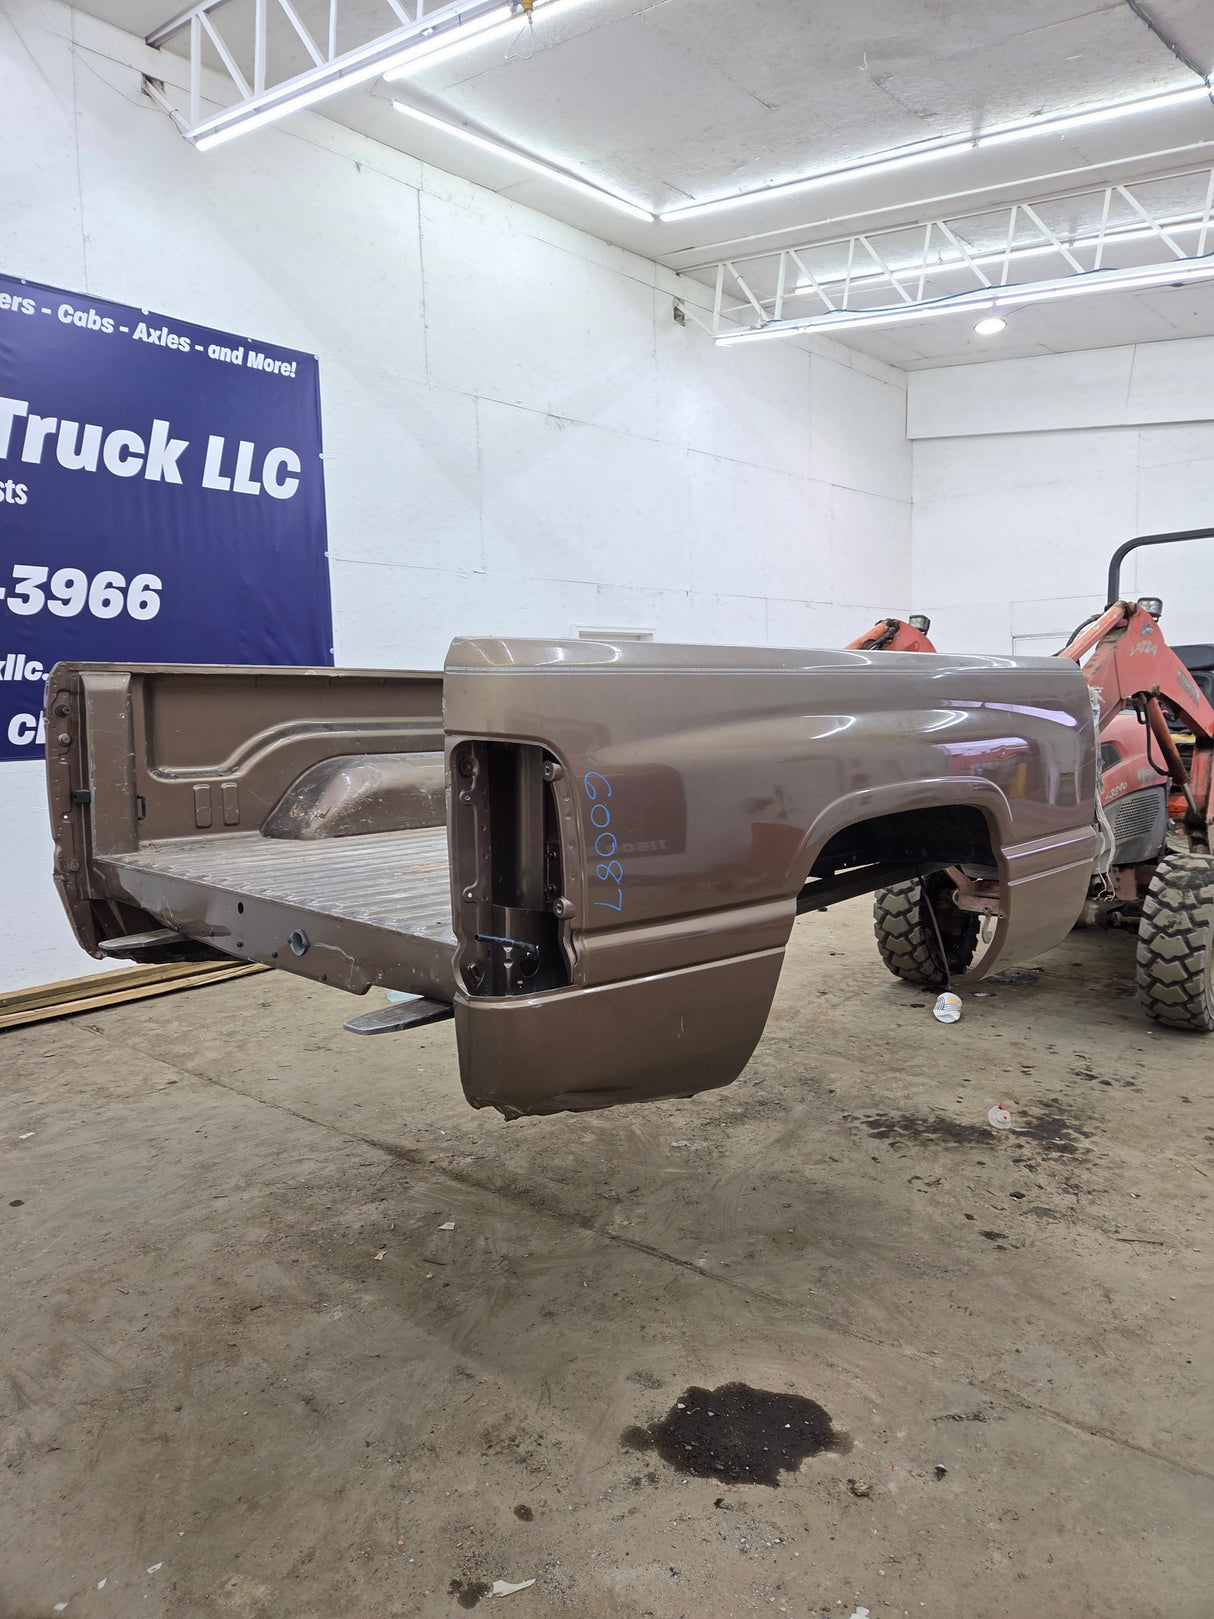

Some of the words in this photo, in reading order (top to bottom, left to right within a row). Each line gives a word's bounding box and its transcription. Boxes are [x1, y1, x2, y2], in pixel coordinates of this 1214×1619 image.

[0, 292, 36, 315] ers
[57, 303, 115, 334] Cabs
[132, 321, 191, 352] Axles
[207, 344, 244, 366] and
[246, 351, 297, 378] More!
[0, 396, 190, 485] Truck
[201, 434, 302, 500] LLC
[0, 564, 163, 621] -3966
[583, 771, 624, 912] 60087
